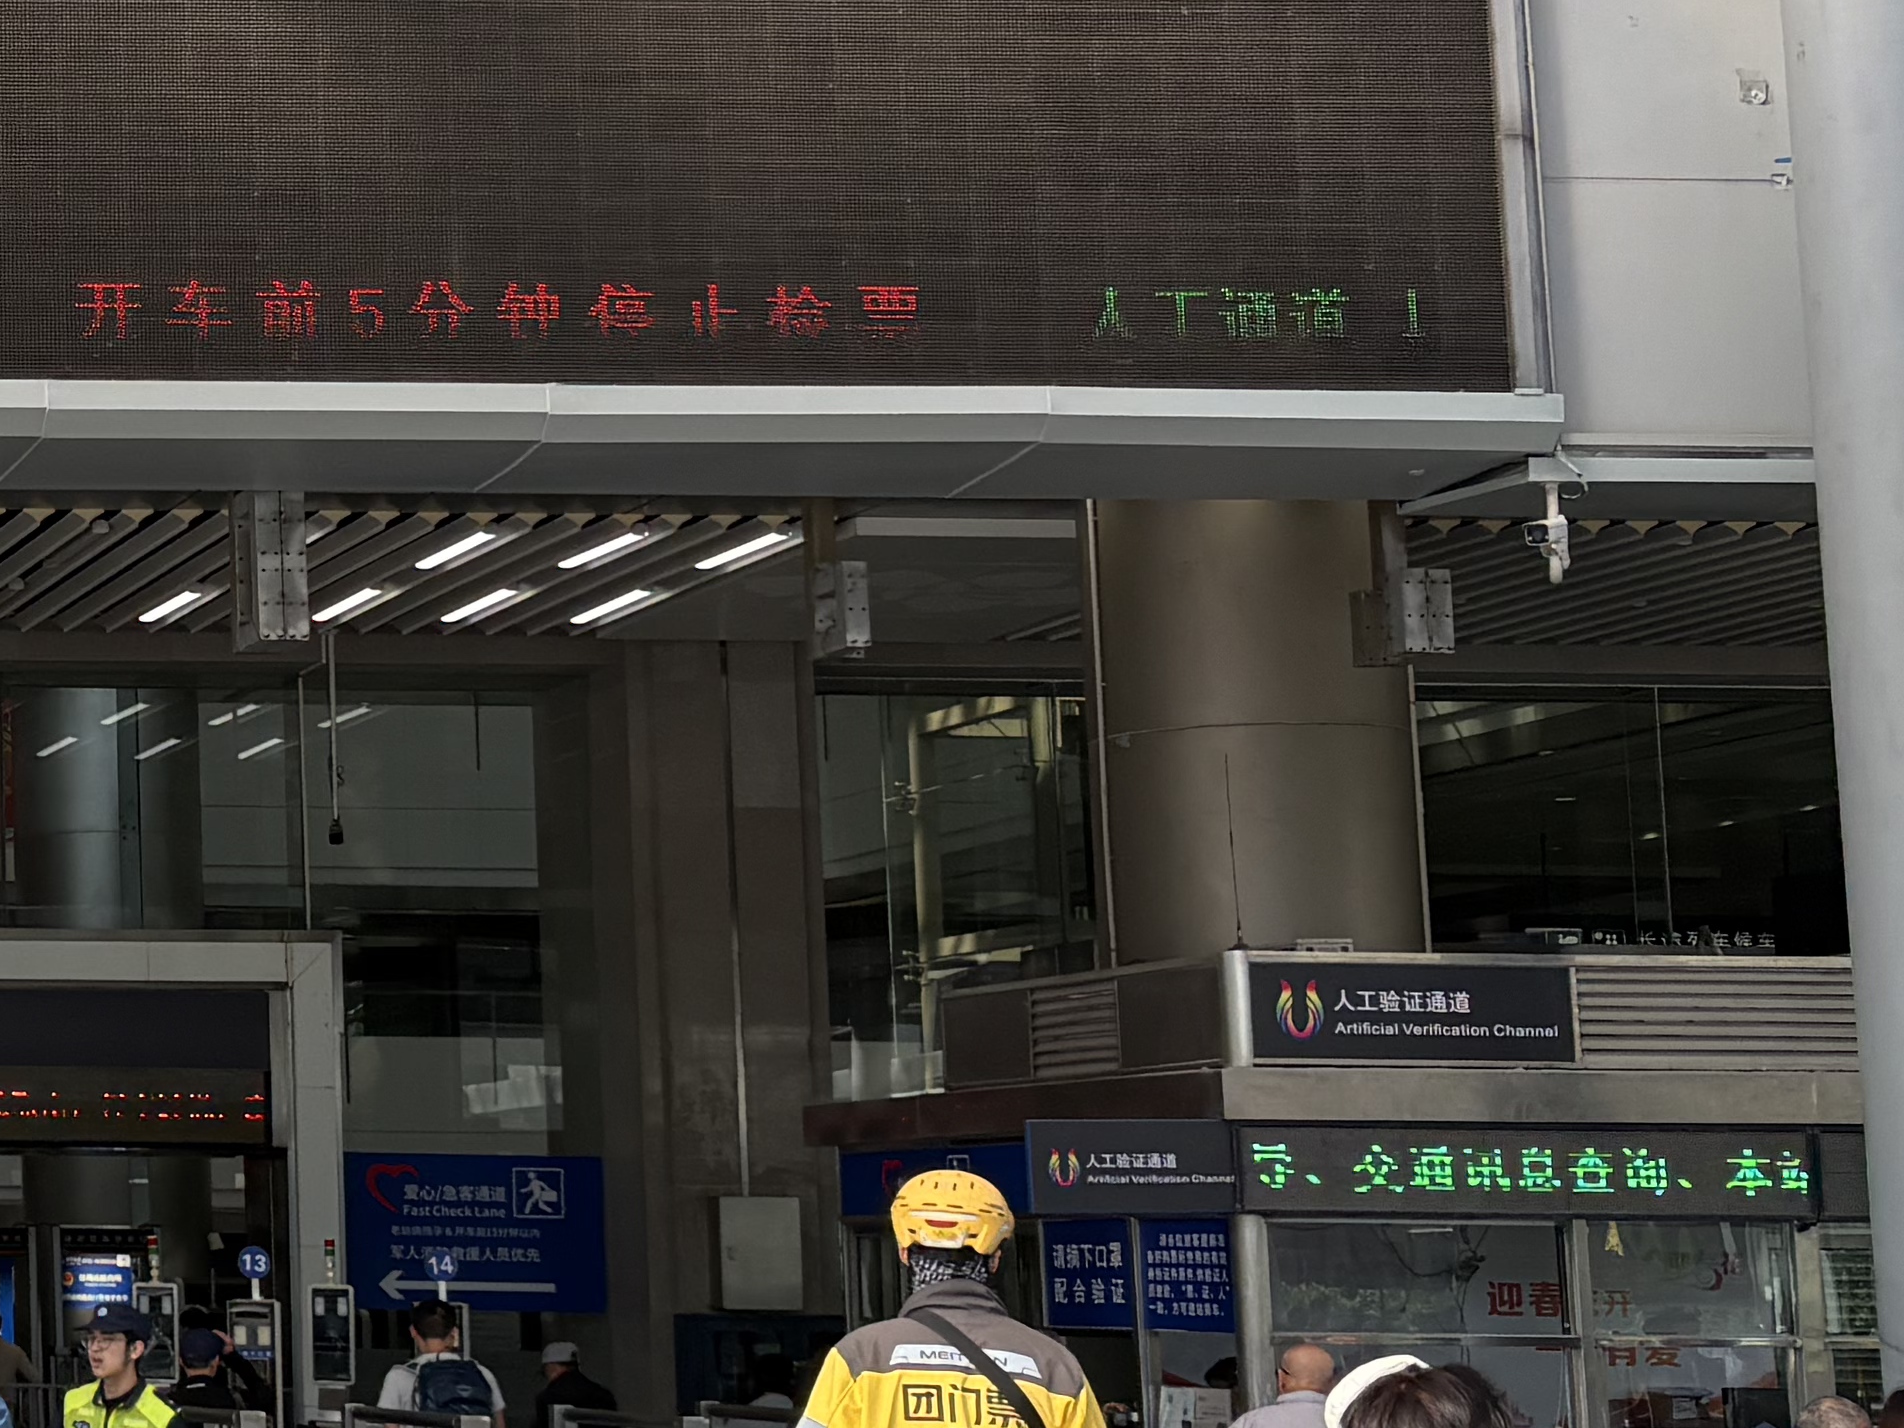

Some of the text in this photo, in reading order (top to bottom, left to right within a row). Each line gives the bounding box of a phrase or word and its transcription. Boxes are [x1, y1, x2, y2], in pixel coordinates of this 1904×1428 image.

[74, 280, 922, 340] 开车前5分钟停止检票
[1334, 988, 1471, 1014] 人工验证通道
[1335, 1021, 1560, 1038] Artificial Verification Channel
[1086, 1152, 1177, 1169] 人工验证通道
[403, 1204, 506, 1219] Fast Check Lane
[242, 1253, 267, 1272] 13
[428, 1255, 454, 1275] 14
[920, 1349, 1008, 1367] MEITN
